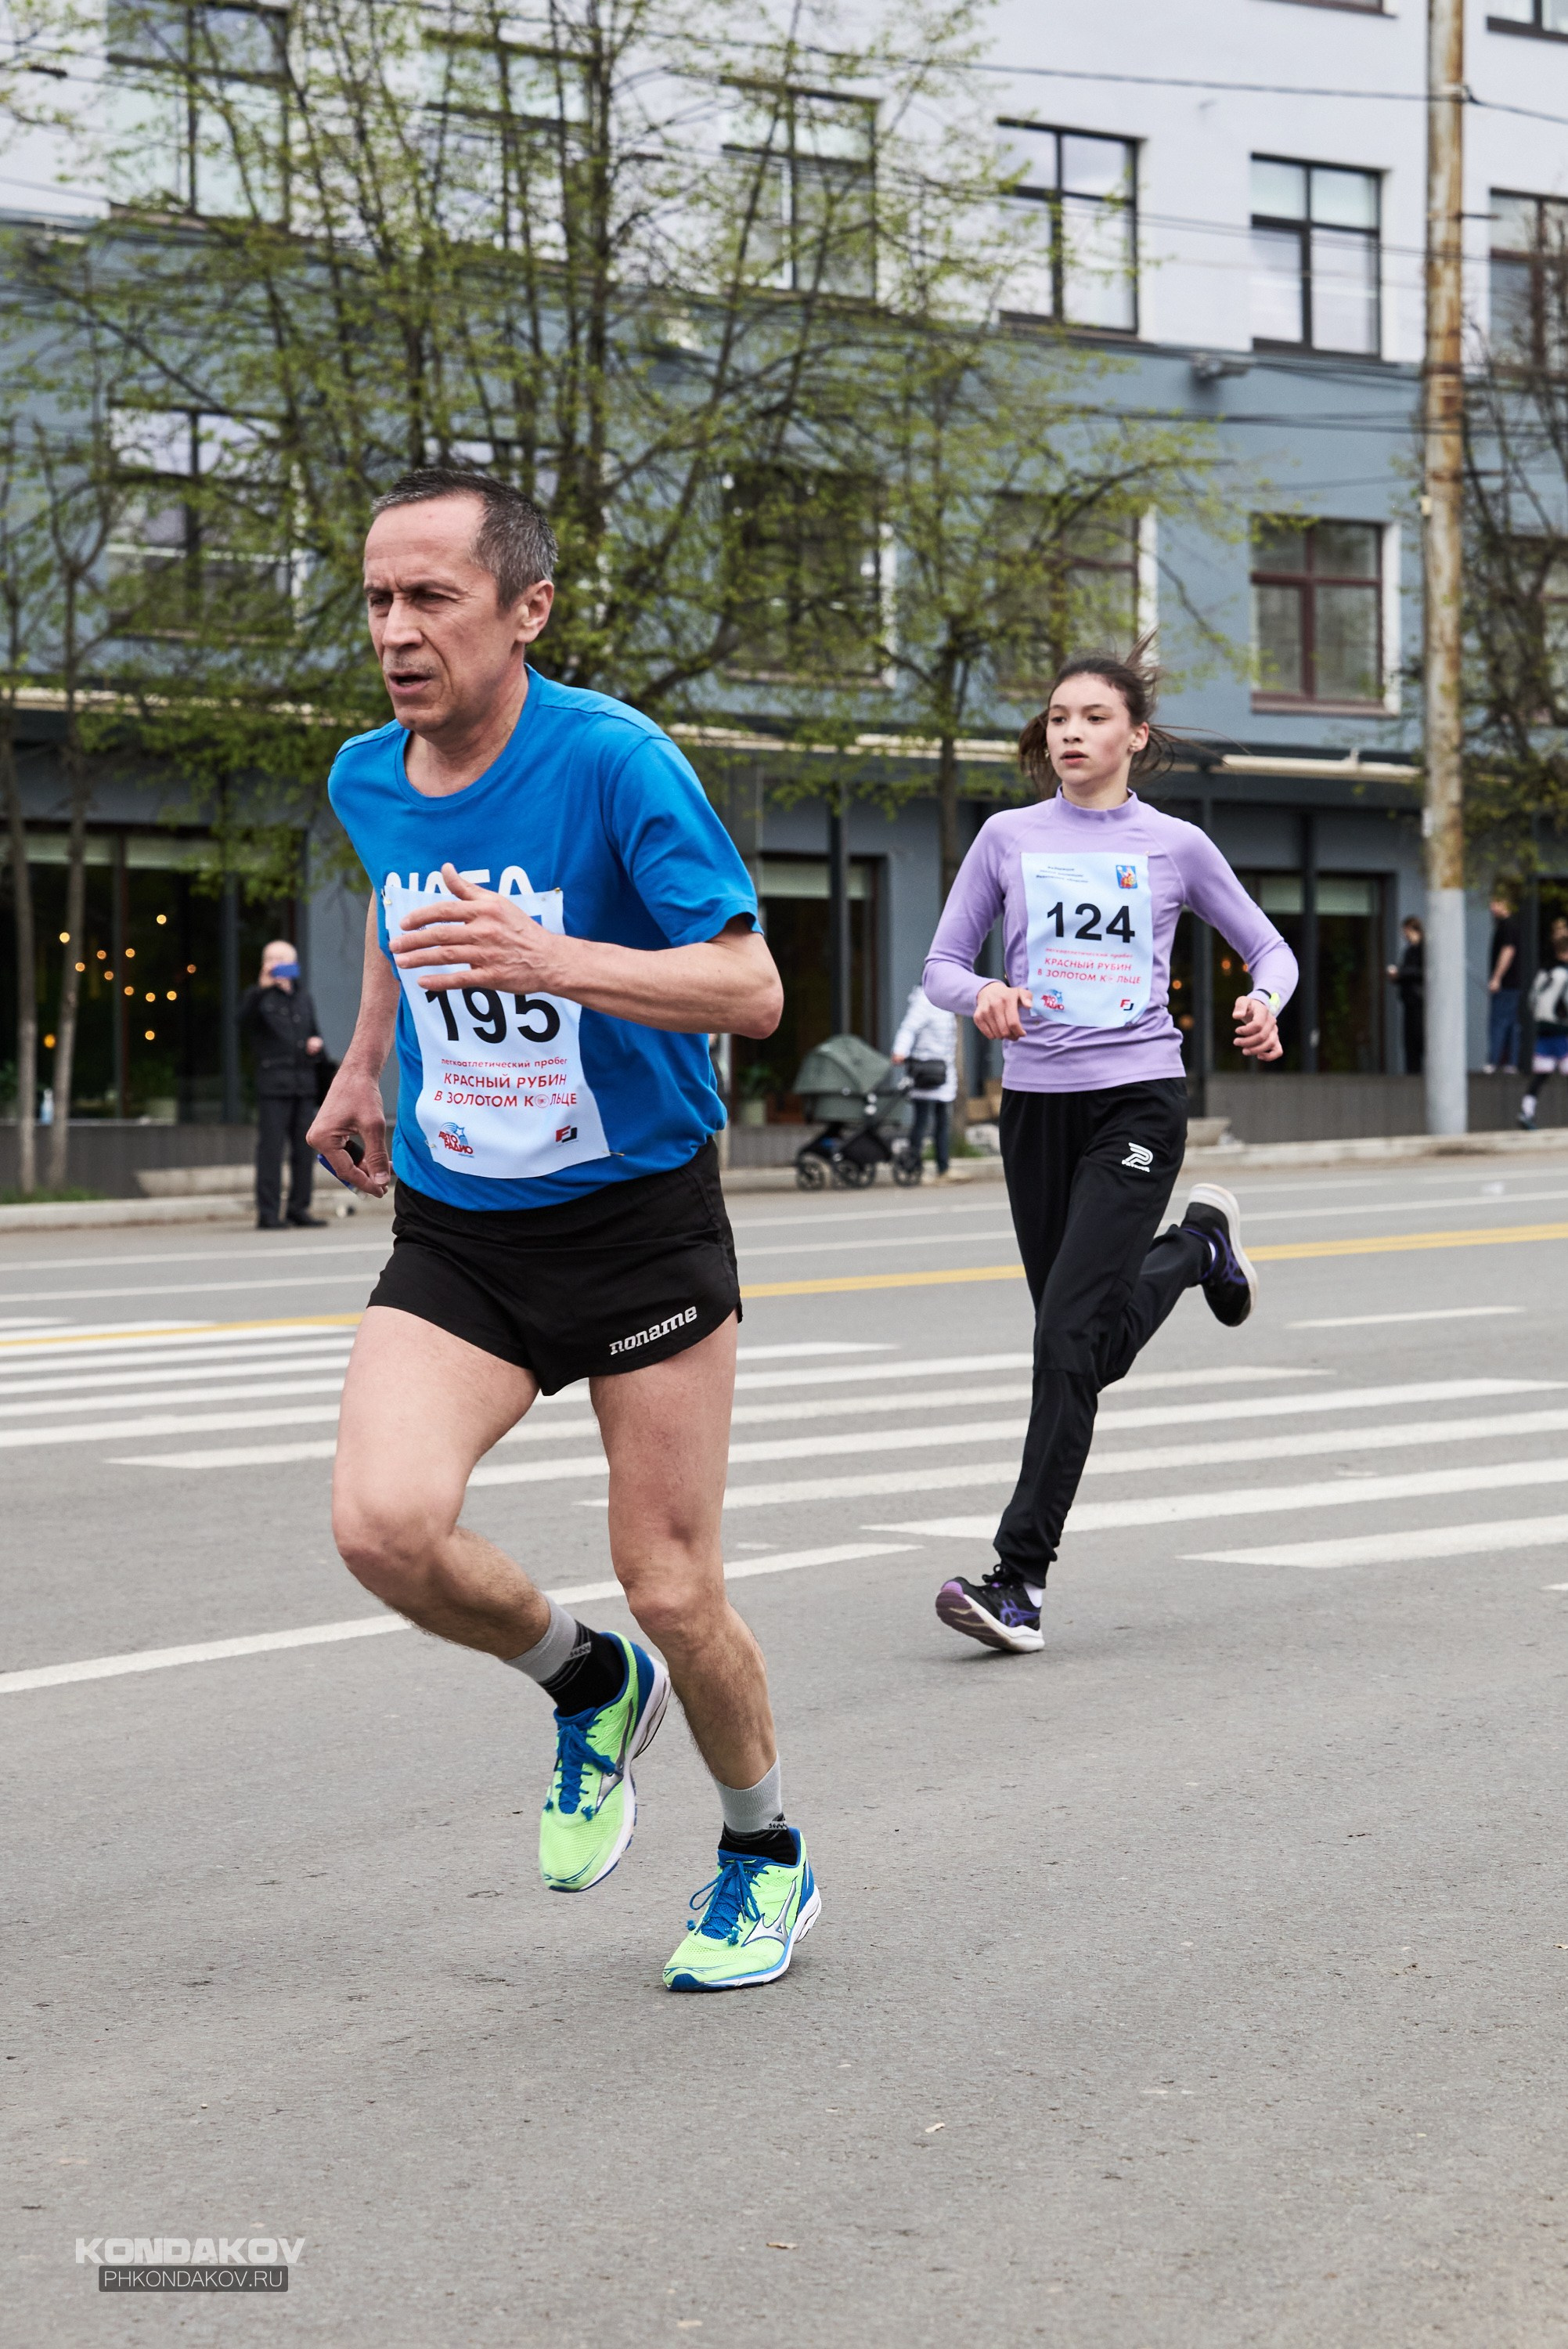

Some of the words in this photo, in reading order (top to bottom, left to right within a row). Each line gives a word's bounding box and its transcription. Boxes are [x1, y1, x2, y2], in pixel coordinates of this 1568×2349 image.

[1047, 901, 1135, 944] 124
[1044, 958, 1094, 969] КРАСНЫЙ
[1098, 962, 1132, 971] РУБИН
[1046, 969, 1096, 981] ЗОЛОТОМ
[424, 986, 561, 1045] 195
[441, 1059, 531, 1068] легкоатлетический
[535, 1056, 568, 1069] пробег
[444, 1073, 510, 1088] КРАСНЫЙ
[517, 1073, 567, 1089] РУБИН
[434, 1091, 443, 1101] В
[447, 1092, 517, 1107] ЗОЛОТОМ
[609, 1305, 697, 1355] noname
